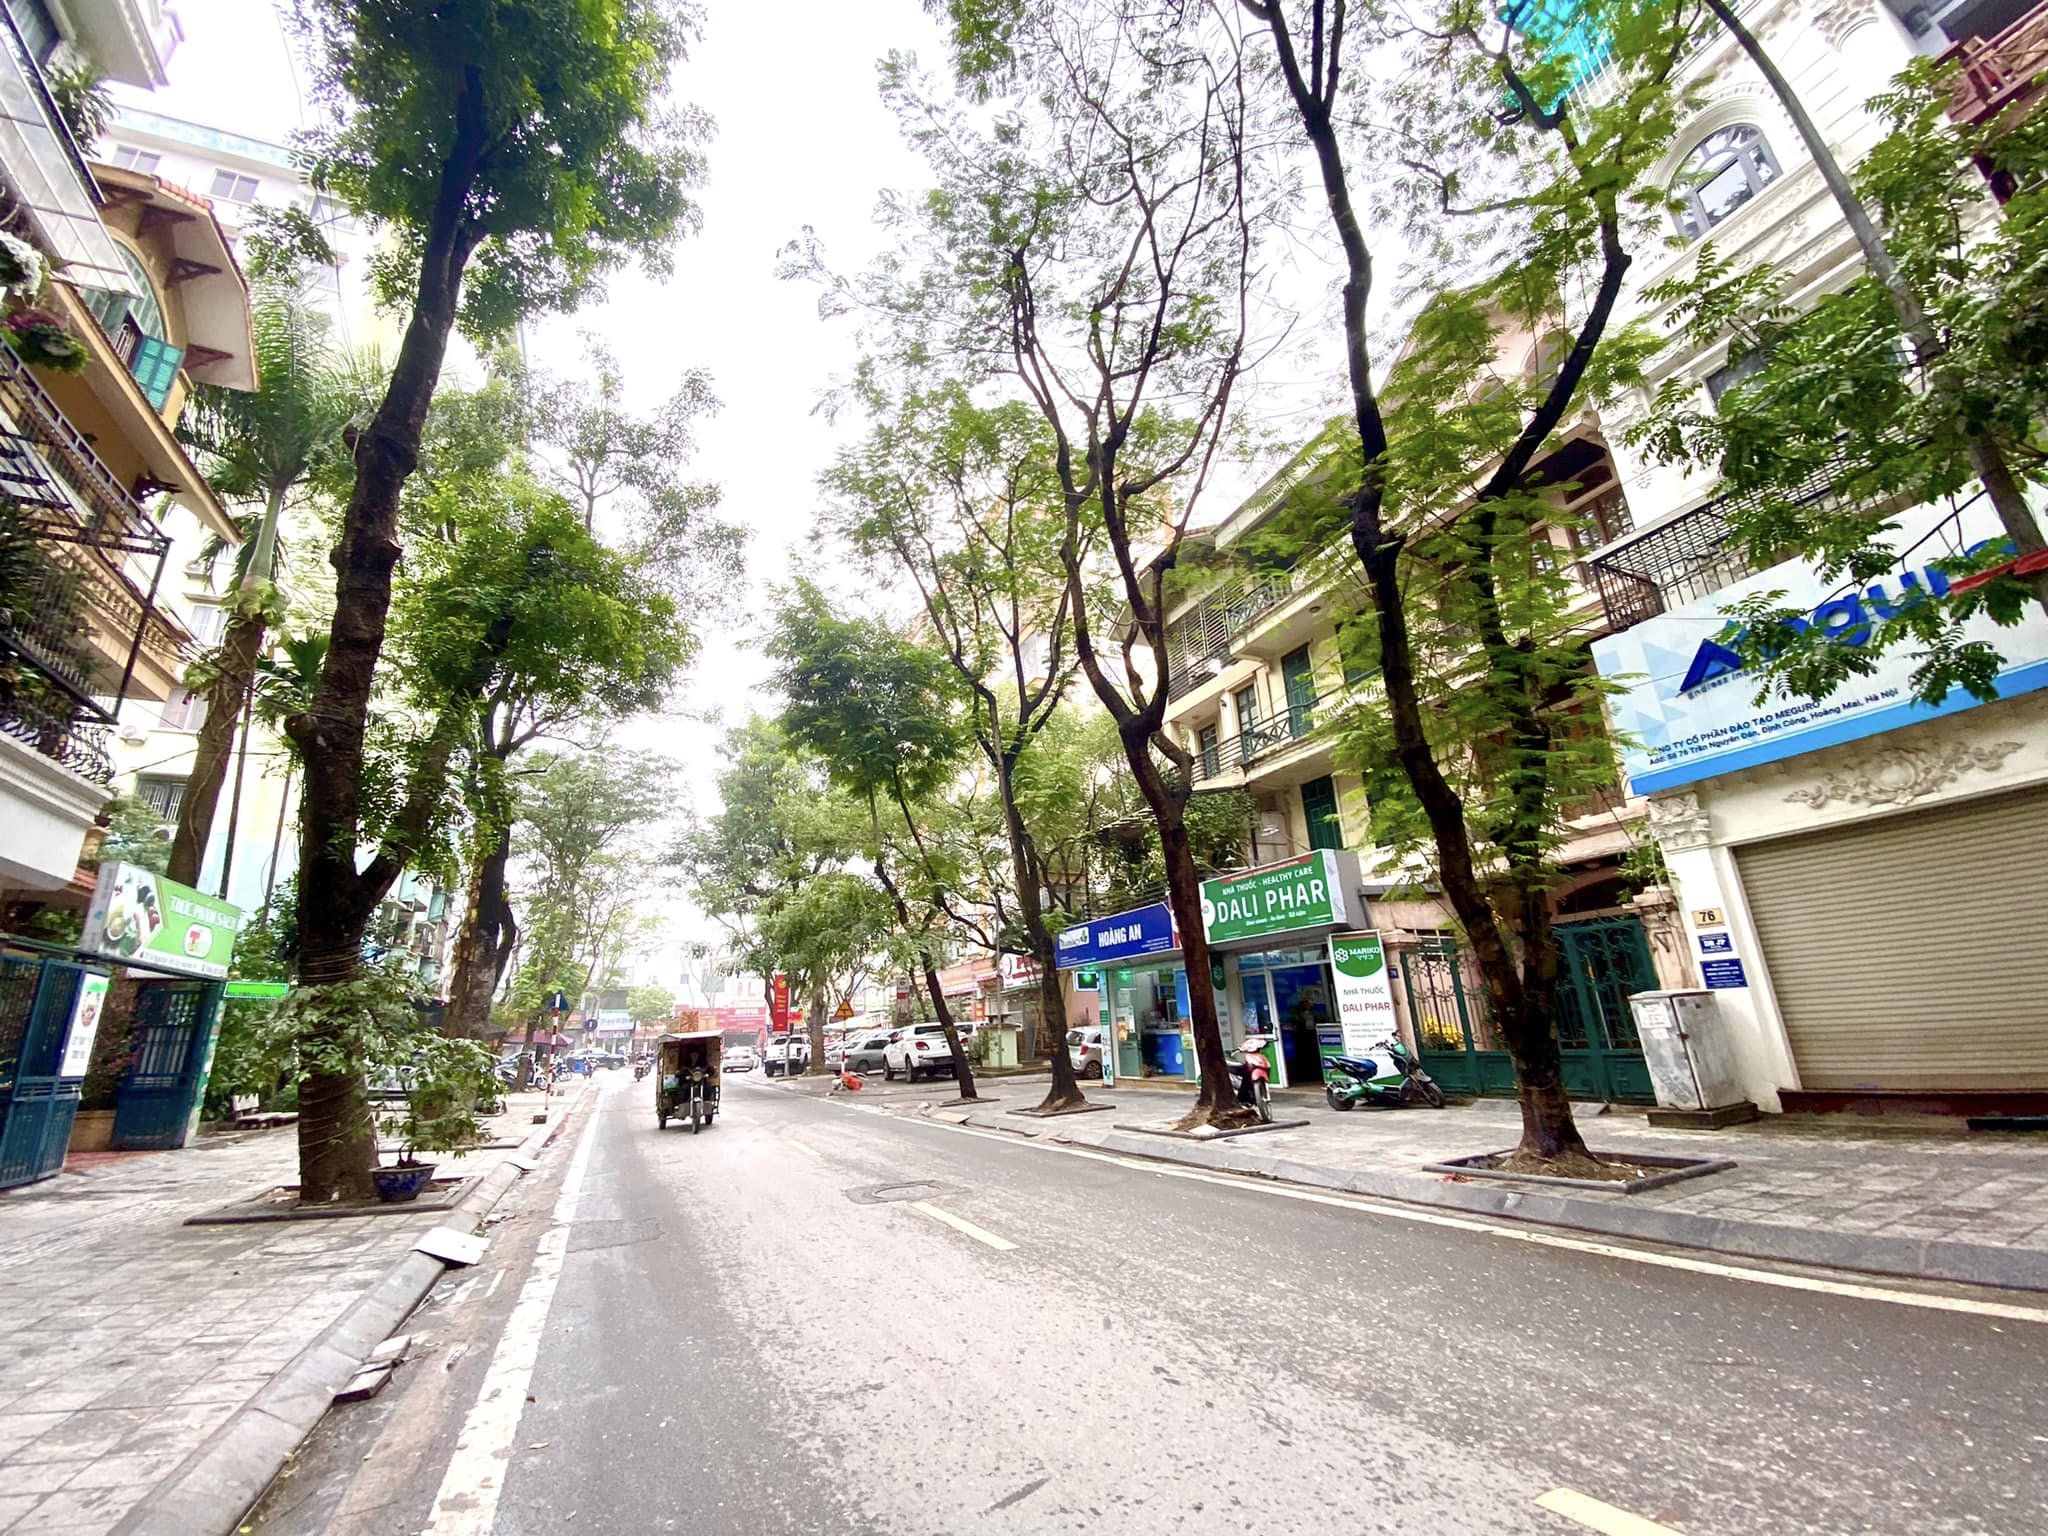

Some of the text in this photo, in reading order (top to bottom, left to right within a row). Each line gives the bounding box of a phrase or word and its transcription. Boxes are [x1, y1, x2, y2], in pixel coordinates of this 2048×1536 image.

[1810, 705, 1841, 722] Hoàng
[1865, 692, 1880, 704] Hà
[1881, 686, 1900, 701] Nội
[1673, 739, 1685, 751] TY
[1729, 719, 1751, 735] ĐÀO
[1753, 712, 1773, 730] TẠO
[1775, 701, 1820, 721] MEGURO
[1262, 872, 1292, 885] HEALTHY
[1294, 865, 1314, 878] CARE
[1217, 894, 1259, 922] DALI
[1265, 878, 1327, 913] PHAR
[1699, 911, 1716, 922] 76
[1098, 927, 1127, 948] HOÀNG
[1129, 923, 1142, 941] AN
[1349, 946, 1380, 956] MARIKO
[1343, 1002, 1391, 1013] DALI PHAR
